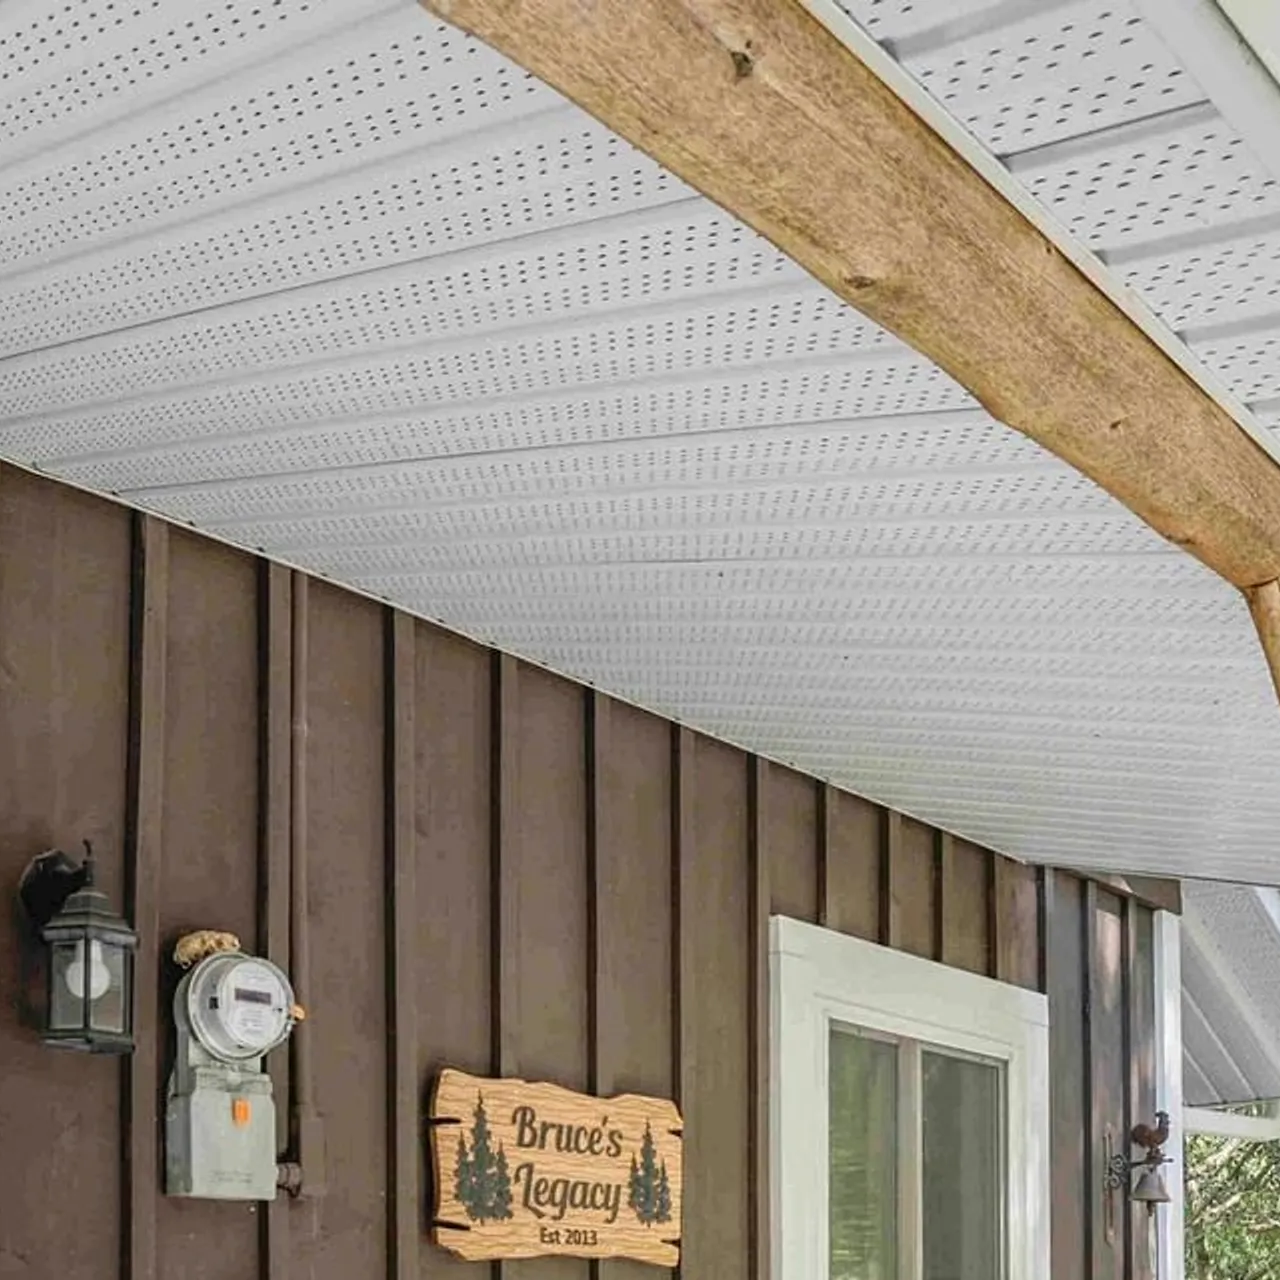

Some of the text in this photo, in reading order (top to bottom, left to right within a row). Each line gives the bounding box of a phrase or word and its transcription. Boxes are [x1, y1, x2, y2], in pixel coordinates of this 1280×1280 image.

[512, 1106, 623, 1157] Bruce's
[514, 1162, 621, 1223] Legacy
[539, 1227, 598, 1246] Est 2013
